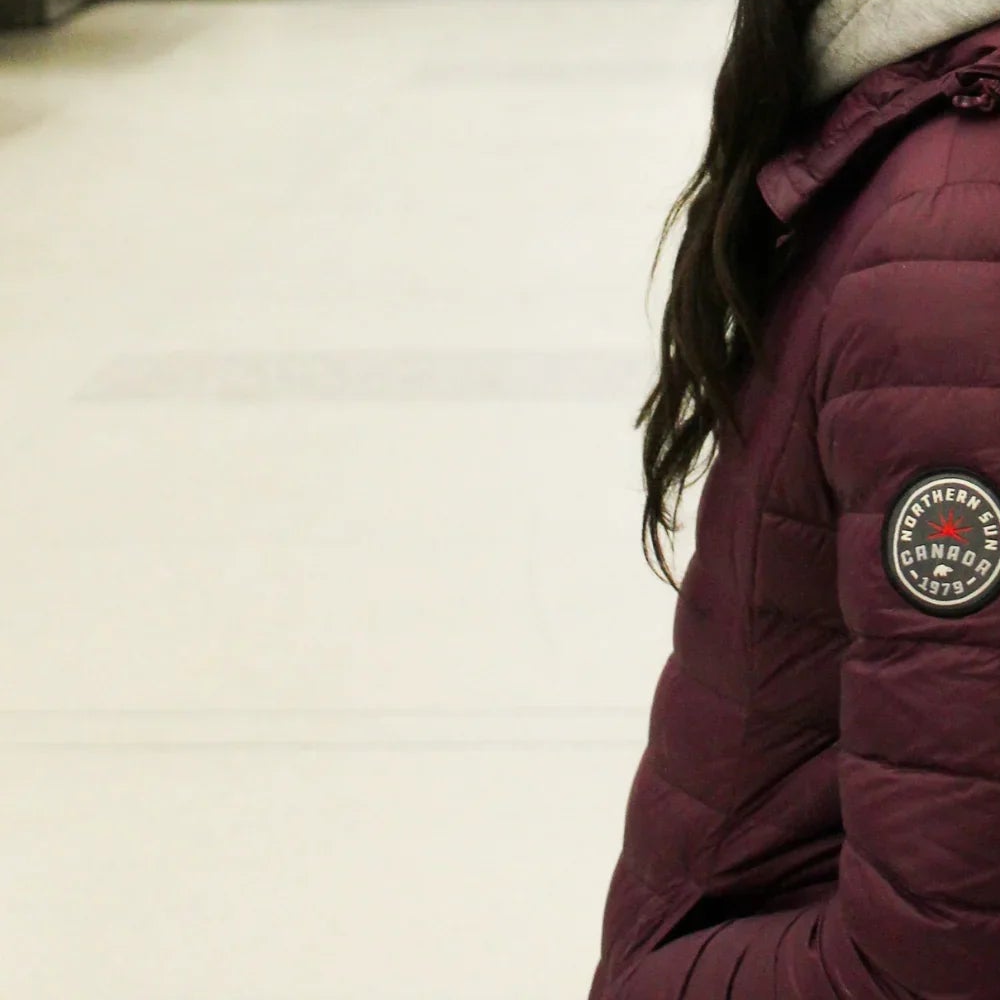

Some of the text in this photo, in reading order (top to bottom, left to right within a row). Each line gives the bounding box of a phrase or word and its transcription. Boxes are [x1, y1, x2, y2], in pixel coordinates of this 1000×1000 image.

[902, 489, 998, 550] NORTHERN SUN
[901, 544, 991, 575] CANADA
